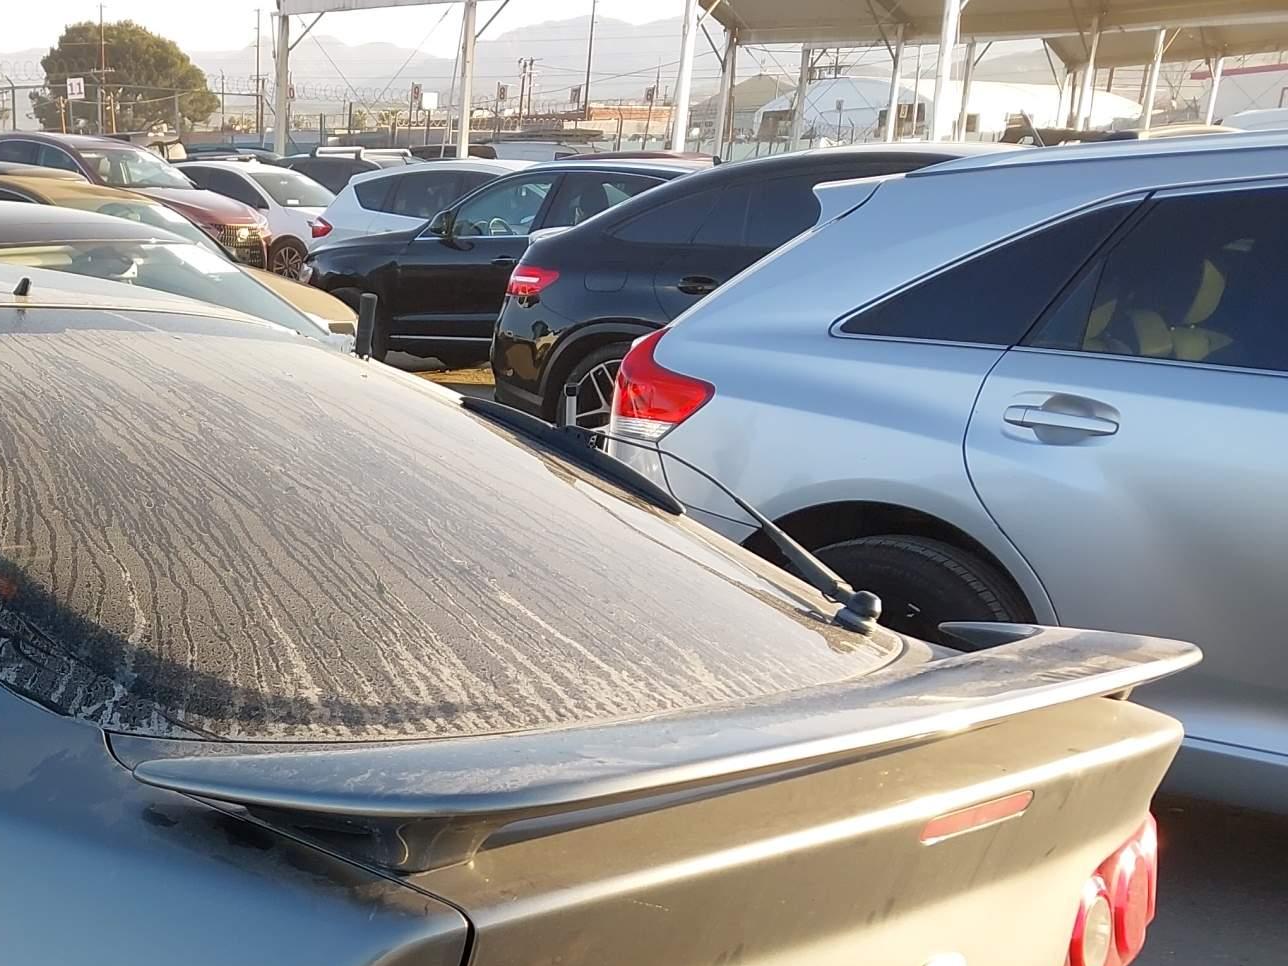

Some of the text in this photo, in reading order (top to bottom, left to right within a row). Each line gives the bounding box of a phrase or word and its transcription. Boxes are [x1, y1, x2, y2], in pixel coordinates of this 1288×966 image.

[67, 81, 84, 97] 11
[413, 86, 421, 100] 9
[499, 87, 506, 100] 8
